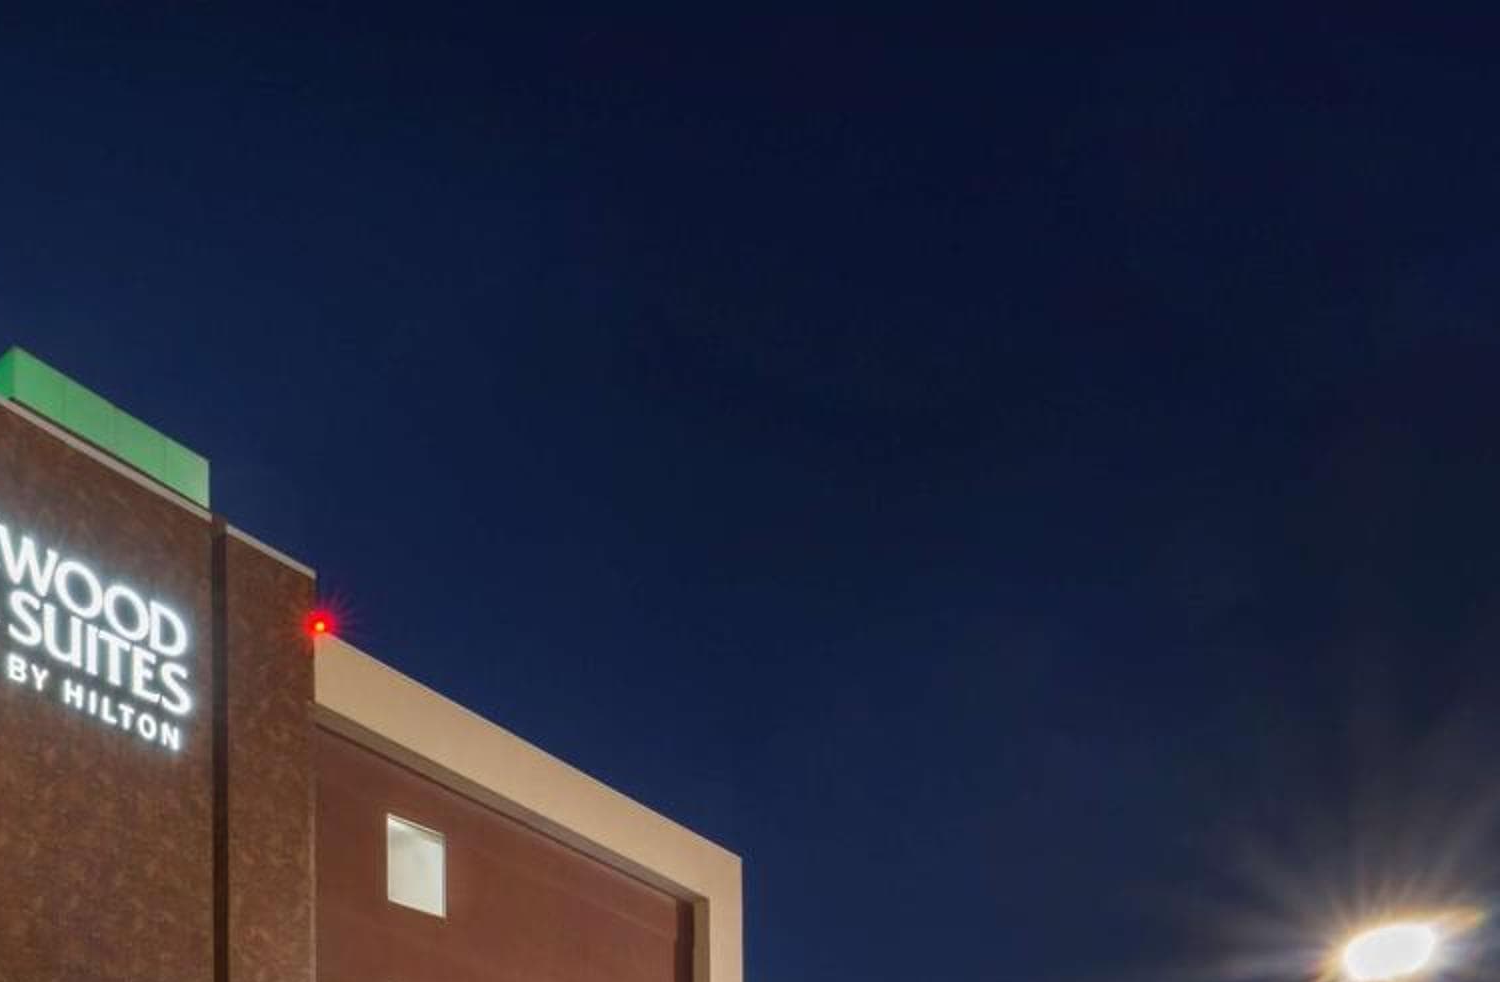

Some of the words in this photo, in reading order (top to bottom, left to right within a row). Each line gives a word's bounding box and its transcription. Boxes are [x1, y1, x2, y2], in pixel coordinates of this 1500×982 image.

[8, 589, 192, 716] SUITES
[8, 653, 50, 692] BY
[63, 682, 182, 752] HILTON
